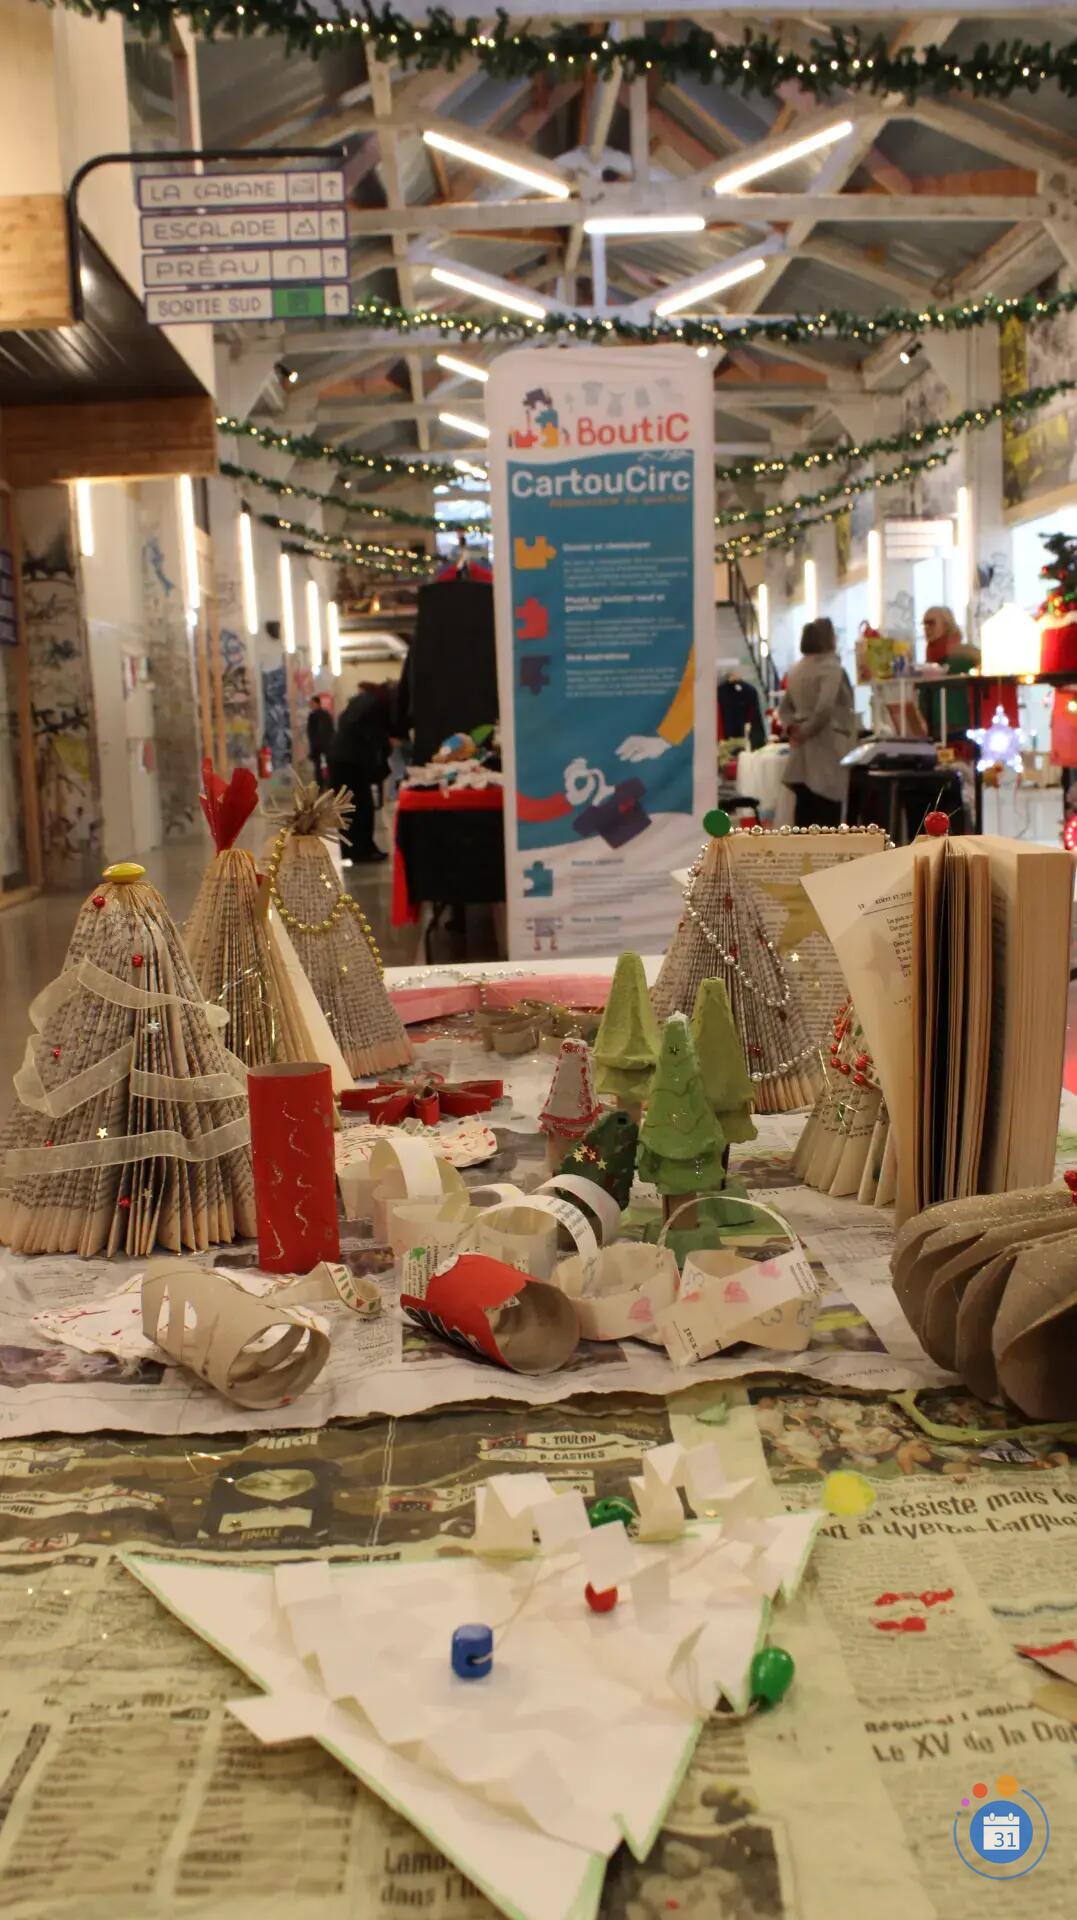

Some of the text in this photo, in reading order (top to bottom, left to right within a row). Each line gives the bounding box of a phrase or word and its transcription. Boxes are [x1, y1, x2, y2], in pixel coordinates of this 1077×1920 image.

[150, 181, 276, 202] LA CABANE
[153, 219, 277, 240] ESCALADE
[156, 253, 260, 278] PRÉAU
[228, 296, 262, 314] SUD
[577, 412, 690, 446] BoutiC
[511, 464, 690, 498] CartouCirc
[553, 1434, 597, 1446] TOULON
[889, 1494, 978, 1520] résiste
[986, 1486, 1049, 1512] mais
[872, 1743, 906, 1763] Le
[912, 1731, 951, 1761] XV
[963, 1732, 995, 1754] de
[999, 1723, 1027, 1747] la
